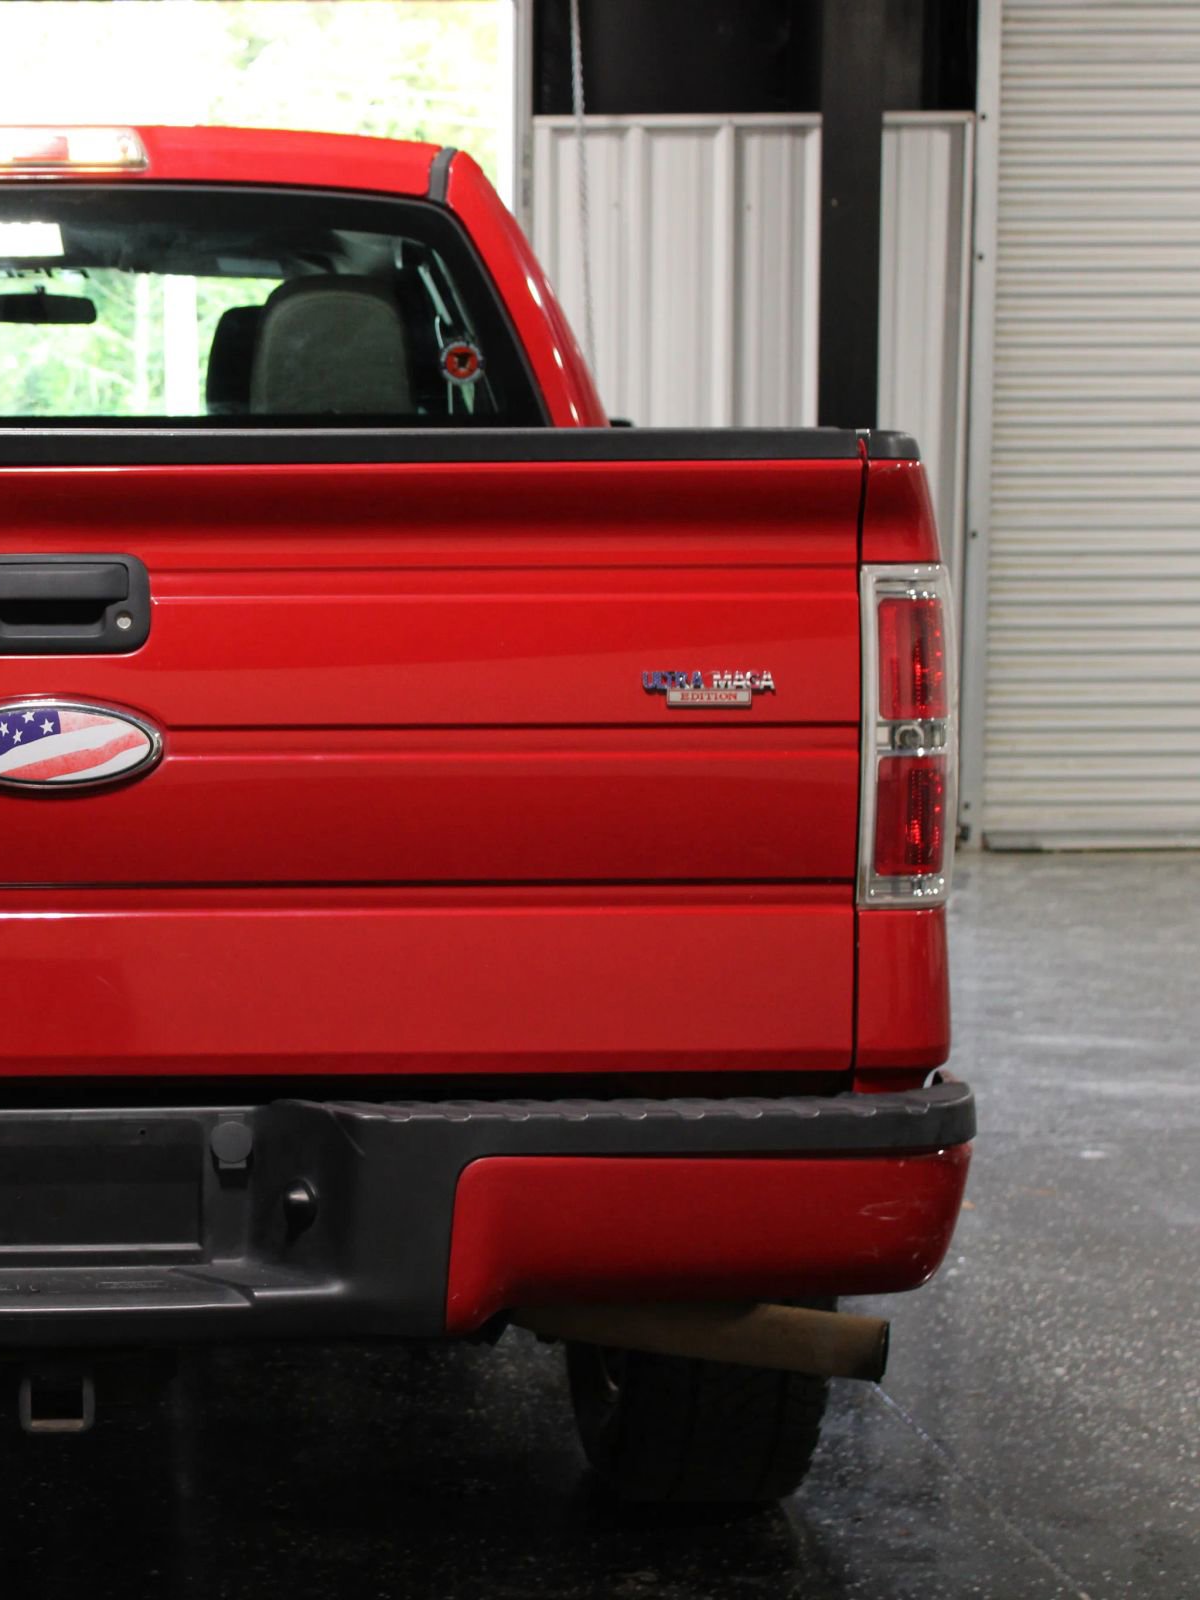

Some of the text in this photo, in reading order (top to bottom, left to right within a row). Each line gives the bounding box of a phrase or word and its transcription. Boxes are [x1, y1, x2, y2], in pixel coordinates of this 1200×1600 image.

[642, 671, 776, 691] ULTRA MAGA
[679, 691, 738, 702] EDITION
